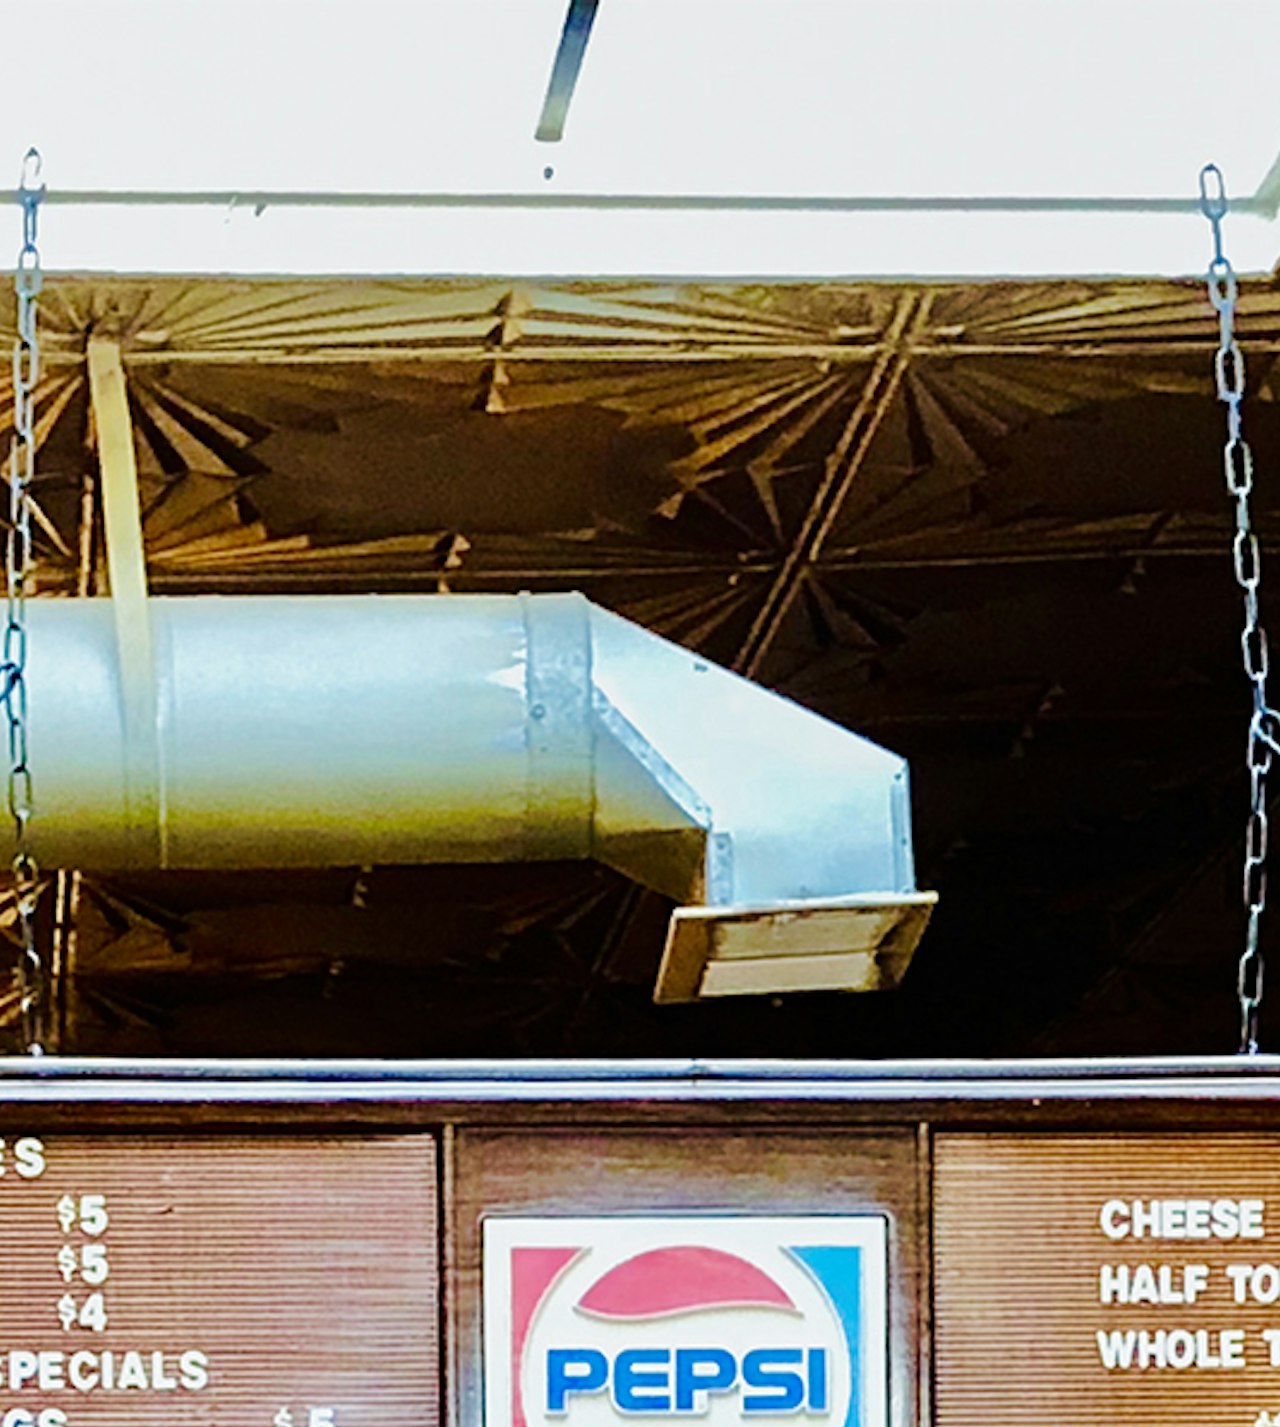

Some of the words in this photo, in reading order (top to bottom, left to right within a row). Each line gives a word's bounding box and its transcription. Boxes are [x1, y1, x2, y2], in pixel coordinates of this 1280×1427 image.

[57, 1195, 108, 1235] $5
[1100, 1199, 1264, 1238] CHEESE
[57, 1244, 109, 1284] $5
[1100, 1264, 1209, 1303] HALF
[57, 1293, 108, 1332] $4
[1097, 1329, 1245, 1369] WHOLE
[546, 1346, 827, 1411] PEPSI
